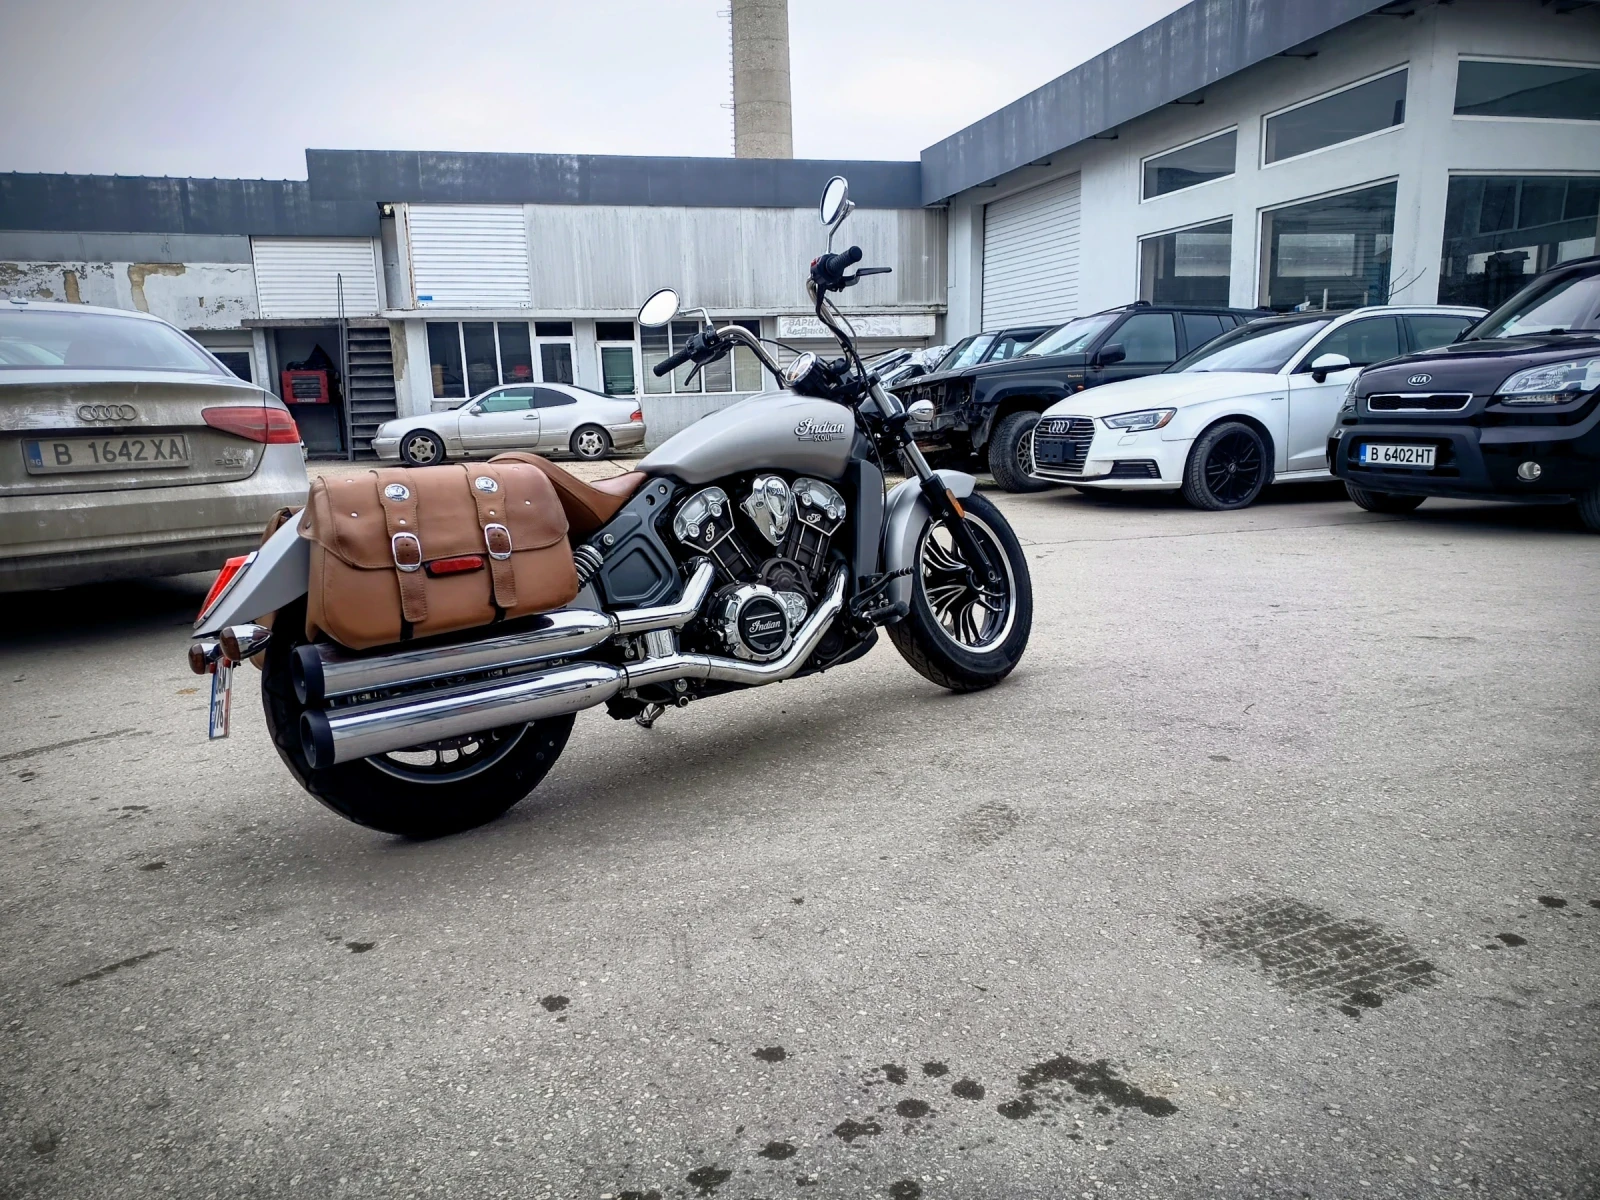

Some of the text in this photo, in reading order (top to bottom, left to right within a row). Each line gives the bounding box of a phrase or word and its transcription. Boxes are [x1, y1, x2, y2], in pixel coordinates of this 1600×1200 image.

[1411, 375, 1427, 383] KIA
[795, 418, 845, 436] Indian
[814, 434, 833, 442] SCOUT
[53, 443, 73, 465] B
[88, 440, 149, 464] 1642
[1384, 446, 1414, 463] 6402
[749, 620, 781, 633] Indian
